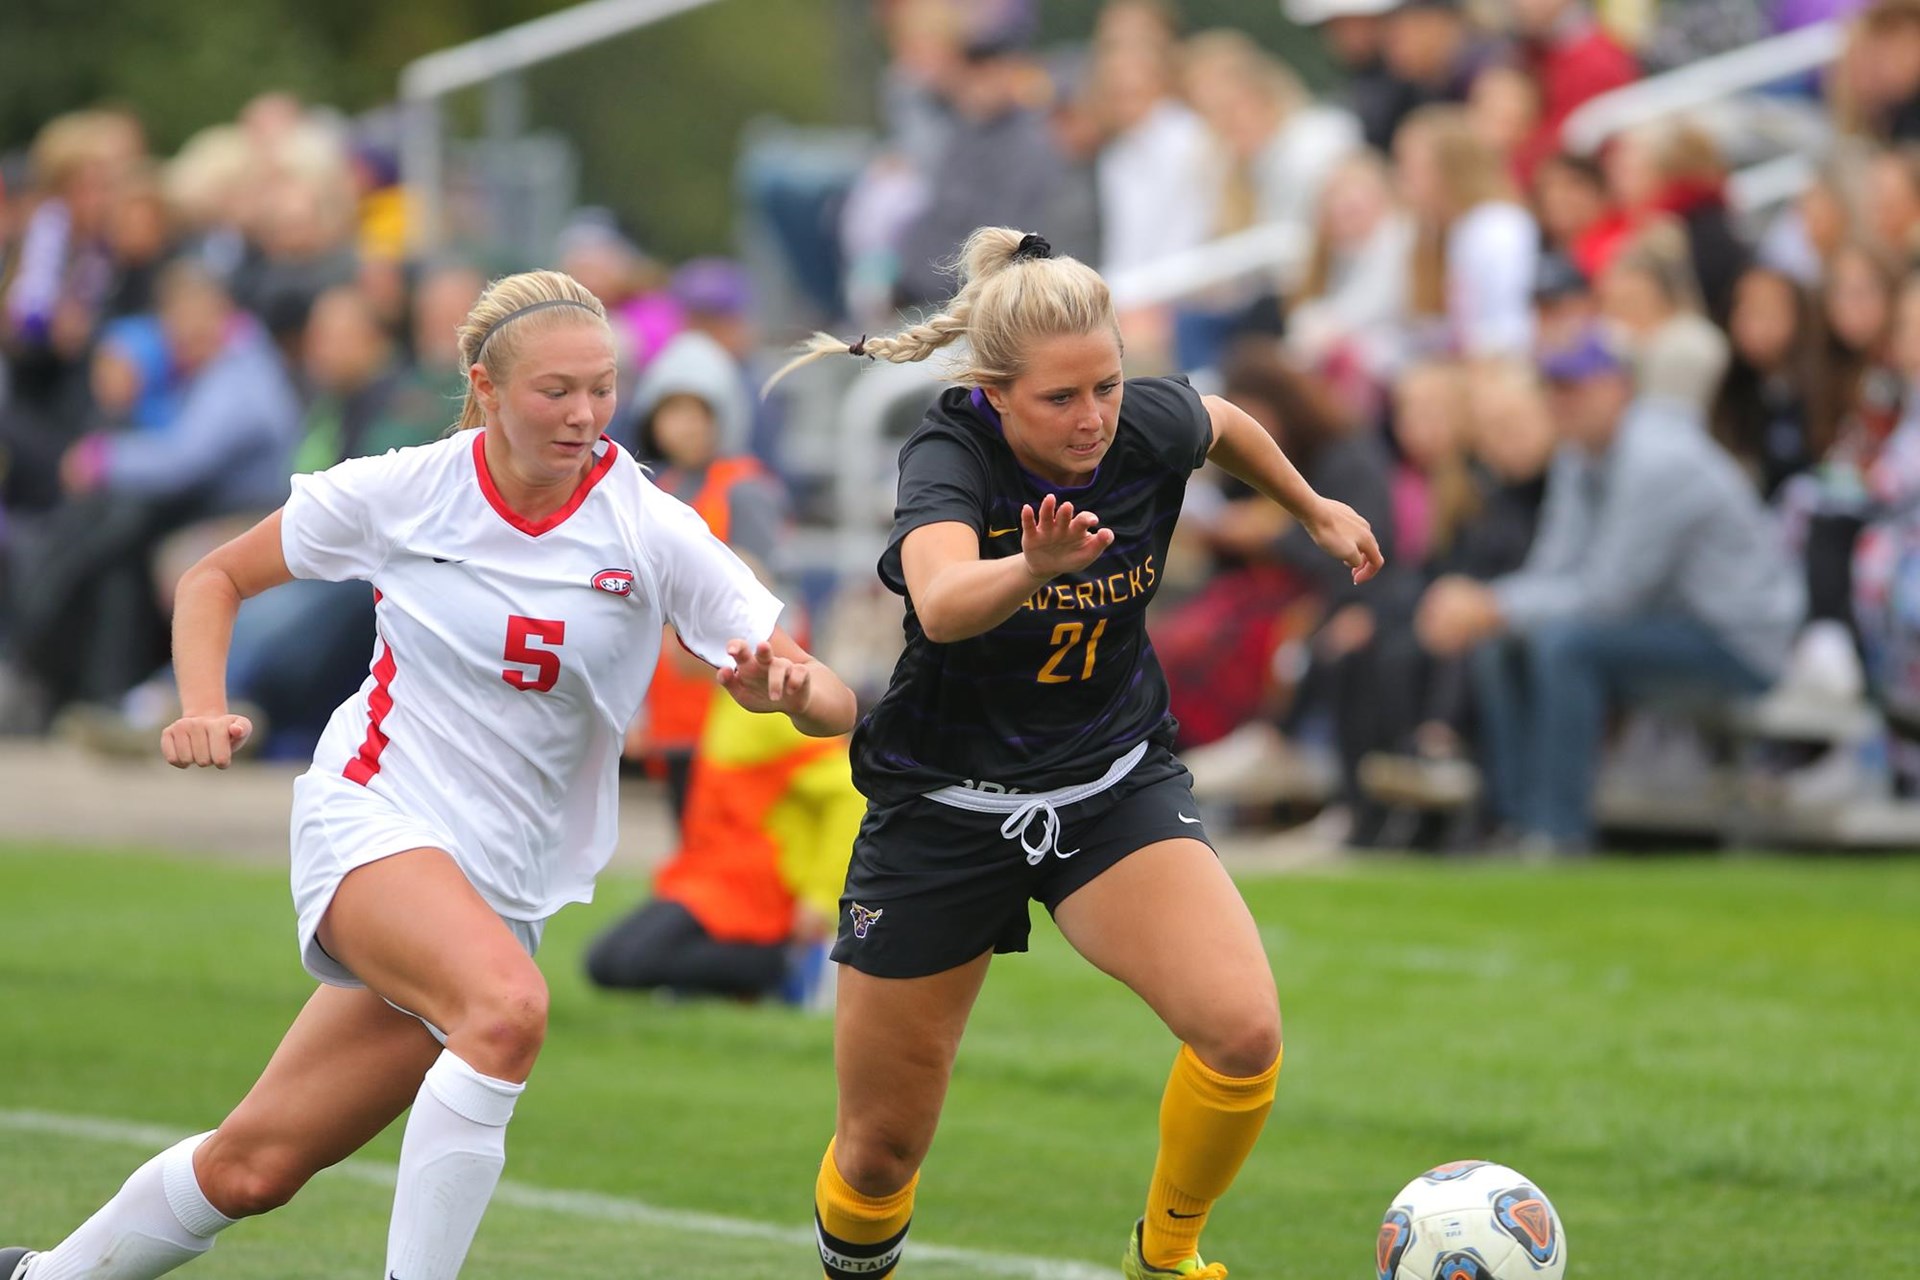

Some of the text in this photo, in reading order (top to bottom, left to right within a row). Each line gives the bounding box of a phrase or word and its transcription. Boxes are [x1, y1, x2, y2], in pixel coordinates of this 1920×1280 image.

[1022, 554, 1156, 611] AVERICKS
[502, 614, 565, 693] 5
[1036, 617, 1108, 684] 21
[822, 1248, 894, 1272] CAPTAIN
